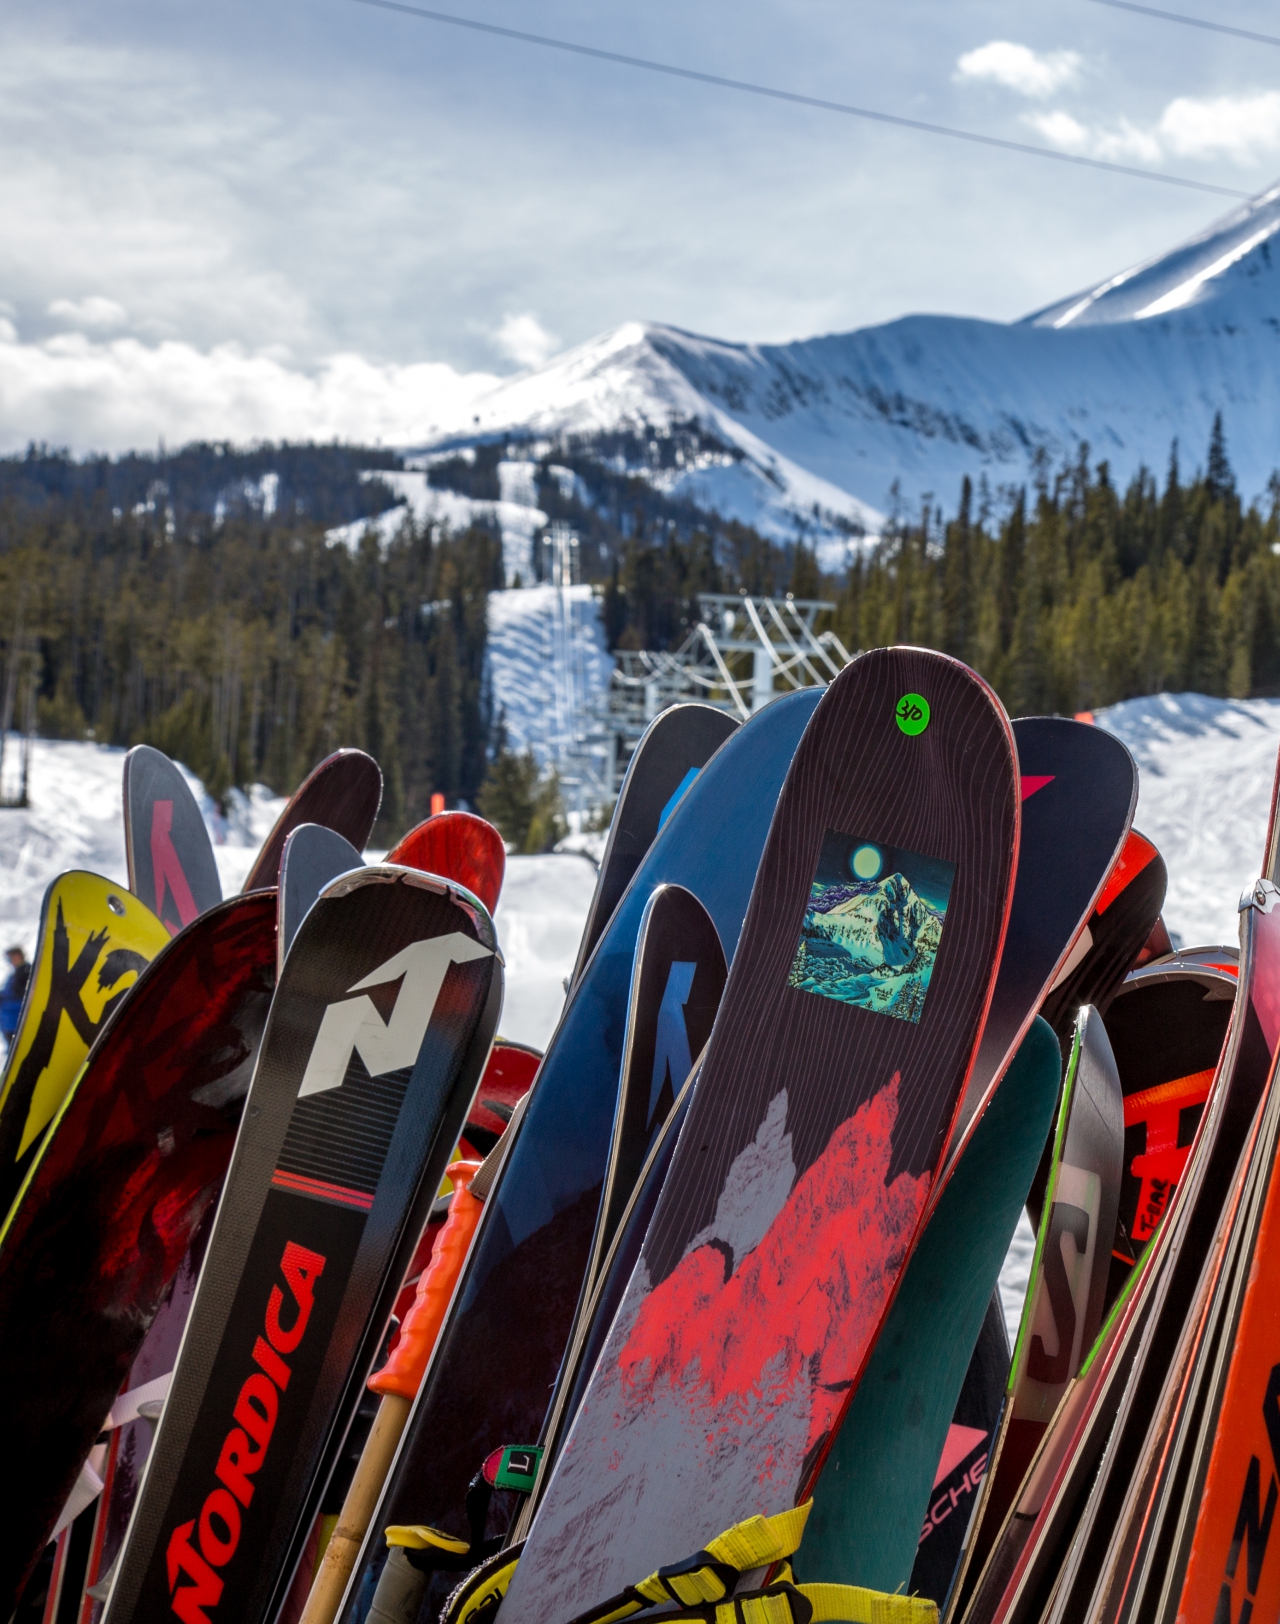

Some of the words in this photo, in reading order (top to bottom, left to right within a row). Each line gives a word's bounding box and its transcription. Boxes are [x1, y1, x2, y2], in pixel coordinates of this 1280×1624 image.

[1140, 1177, 1169, 1233] T-BAR
[166, 1240, 327, 1624] NORDICA
[507, 1454, 530, 1473] L
